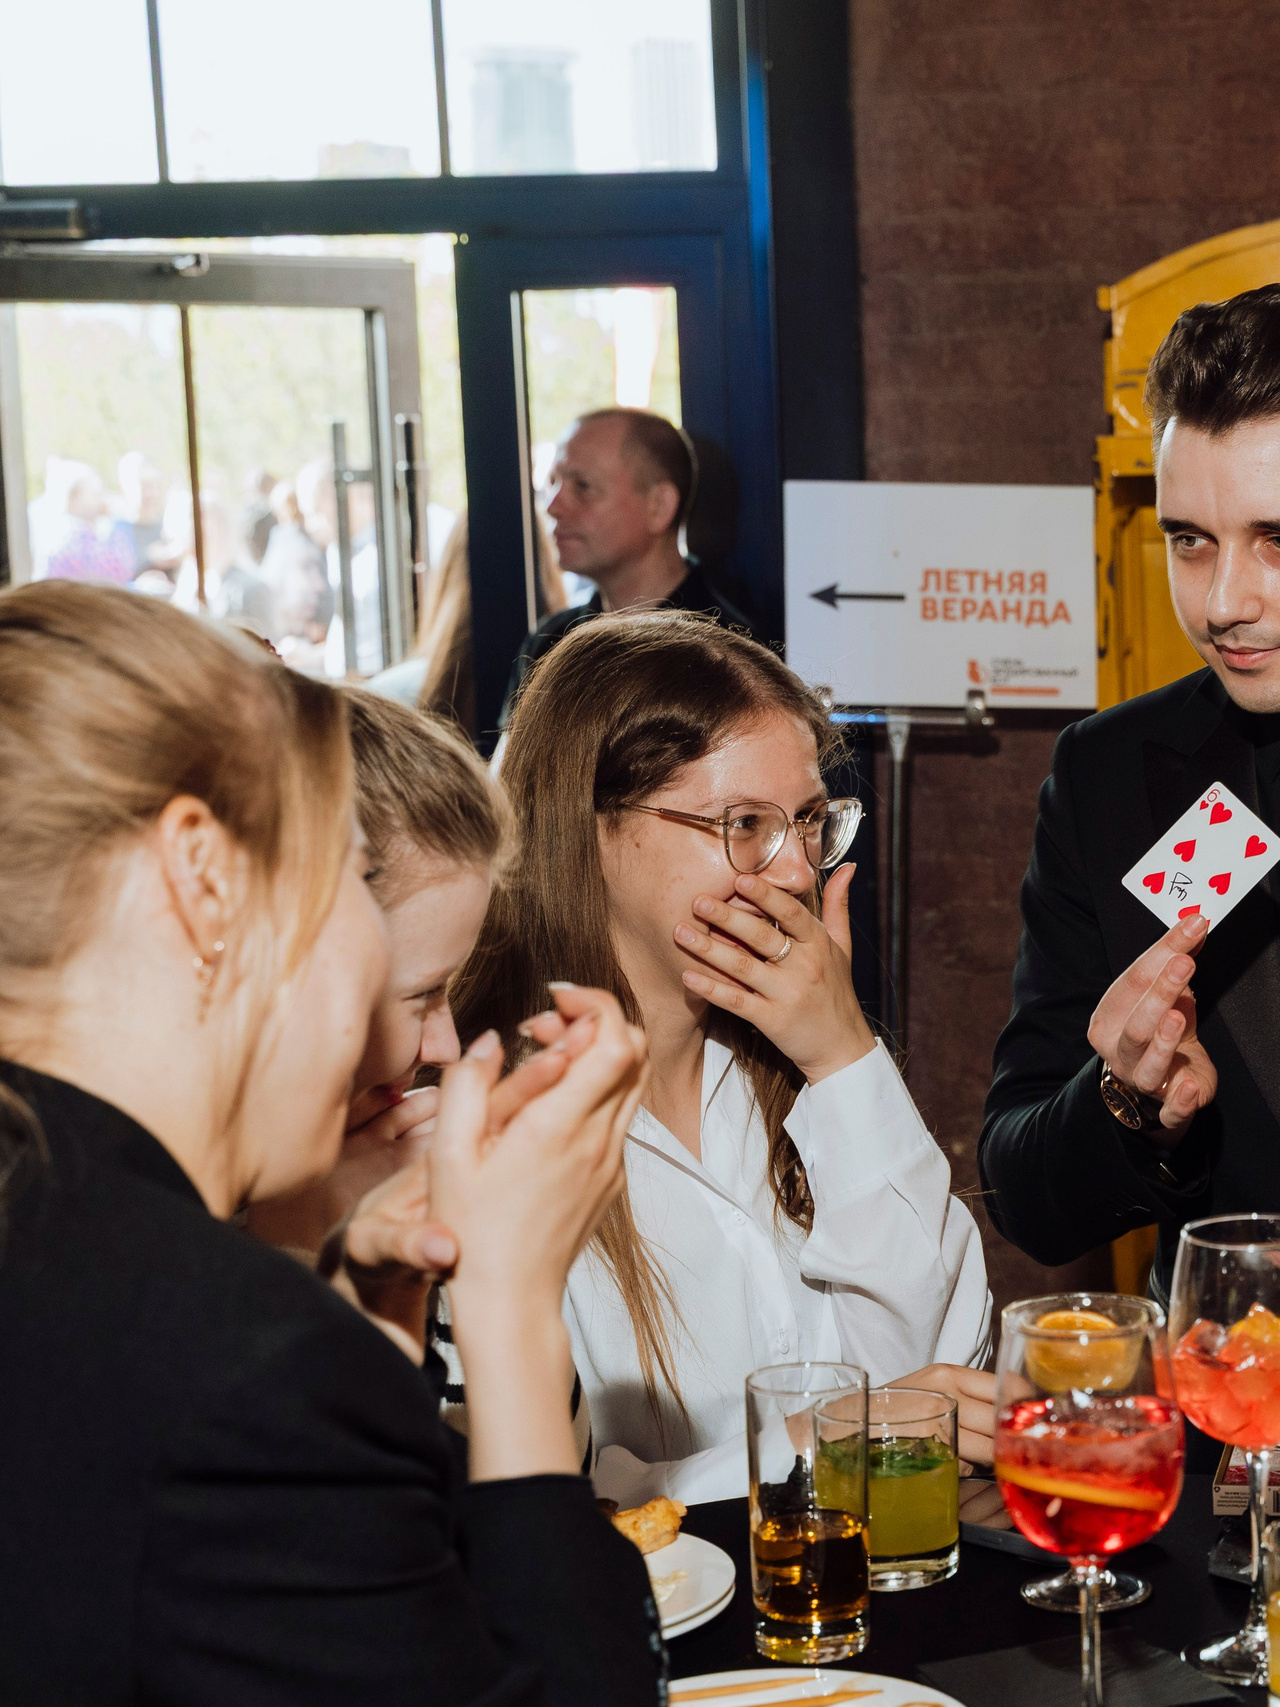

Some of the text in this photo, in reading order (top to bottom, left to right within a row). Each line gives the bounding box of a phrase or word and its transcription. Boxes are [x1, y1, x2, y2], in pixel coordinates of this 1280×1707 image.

[920, 568, 1047, 595] ЛЕТНЯЯ
[920, 597, 1073, 627] ВЕРАНДА
[1206, 788, 1221, 803] 6
